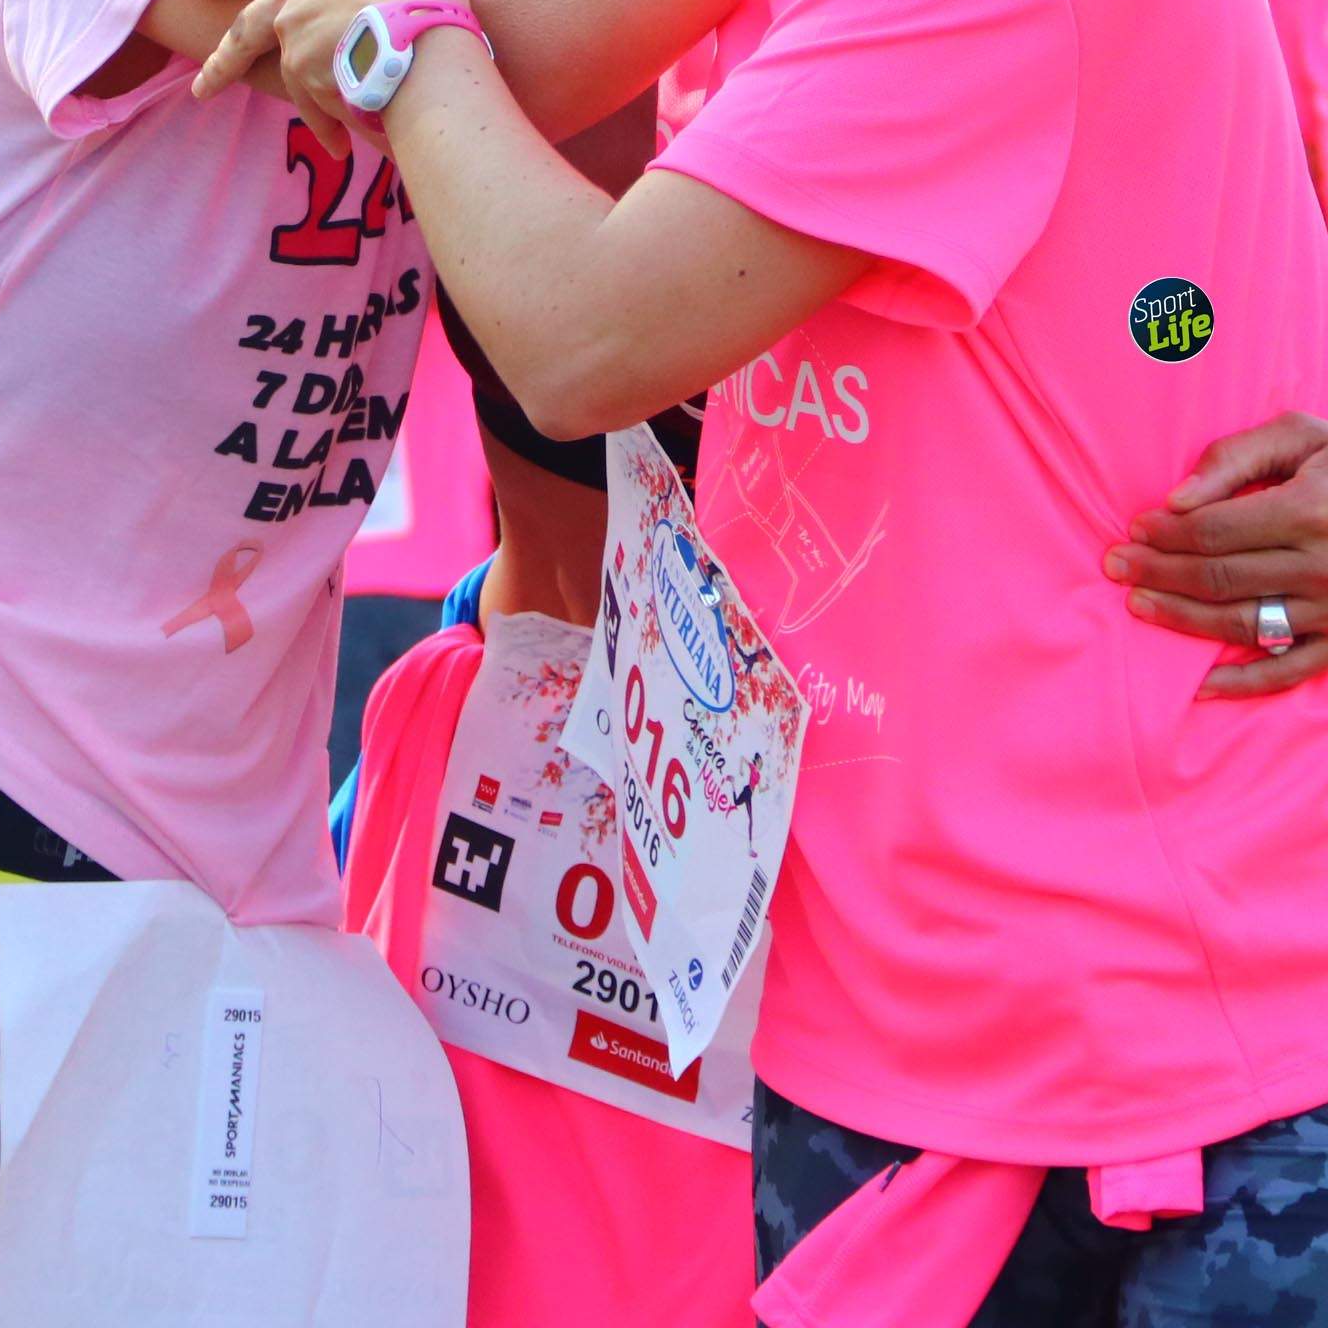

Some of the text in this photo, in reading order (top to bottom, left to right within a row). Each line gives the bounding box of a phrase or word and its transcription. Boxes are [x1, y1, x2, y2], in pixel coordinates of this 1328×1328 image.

[1134, 286, 1197, 323] Sport
[238, 315, 306, 354] 24
[1147, 309, 1212, 352] Life
[253, 370, 287, 408] 7
[214, 421, 258, 464] A
[273, 429, 334, 470] LA
[653, 539, 721, 702] ASTURIANA
[624, 664, 691, 840] 016
[683, 698, 726, 776] Carrera
[607, 956, 646, 980] VIOLEN
[420, 966, 531, 1025] OYSHO
[572, 960, 659, 1023] 2901
[669, 969, 697, 1035] ZURICH
[224, 1008, 262, 1024] 29015
[609, 1040, 673, 1074] Santand
[209, 1195, 248, 1210] 29015
